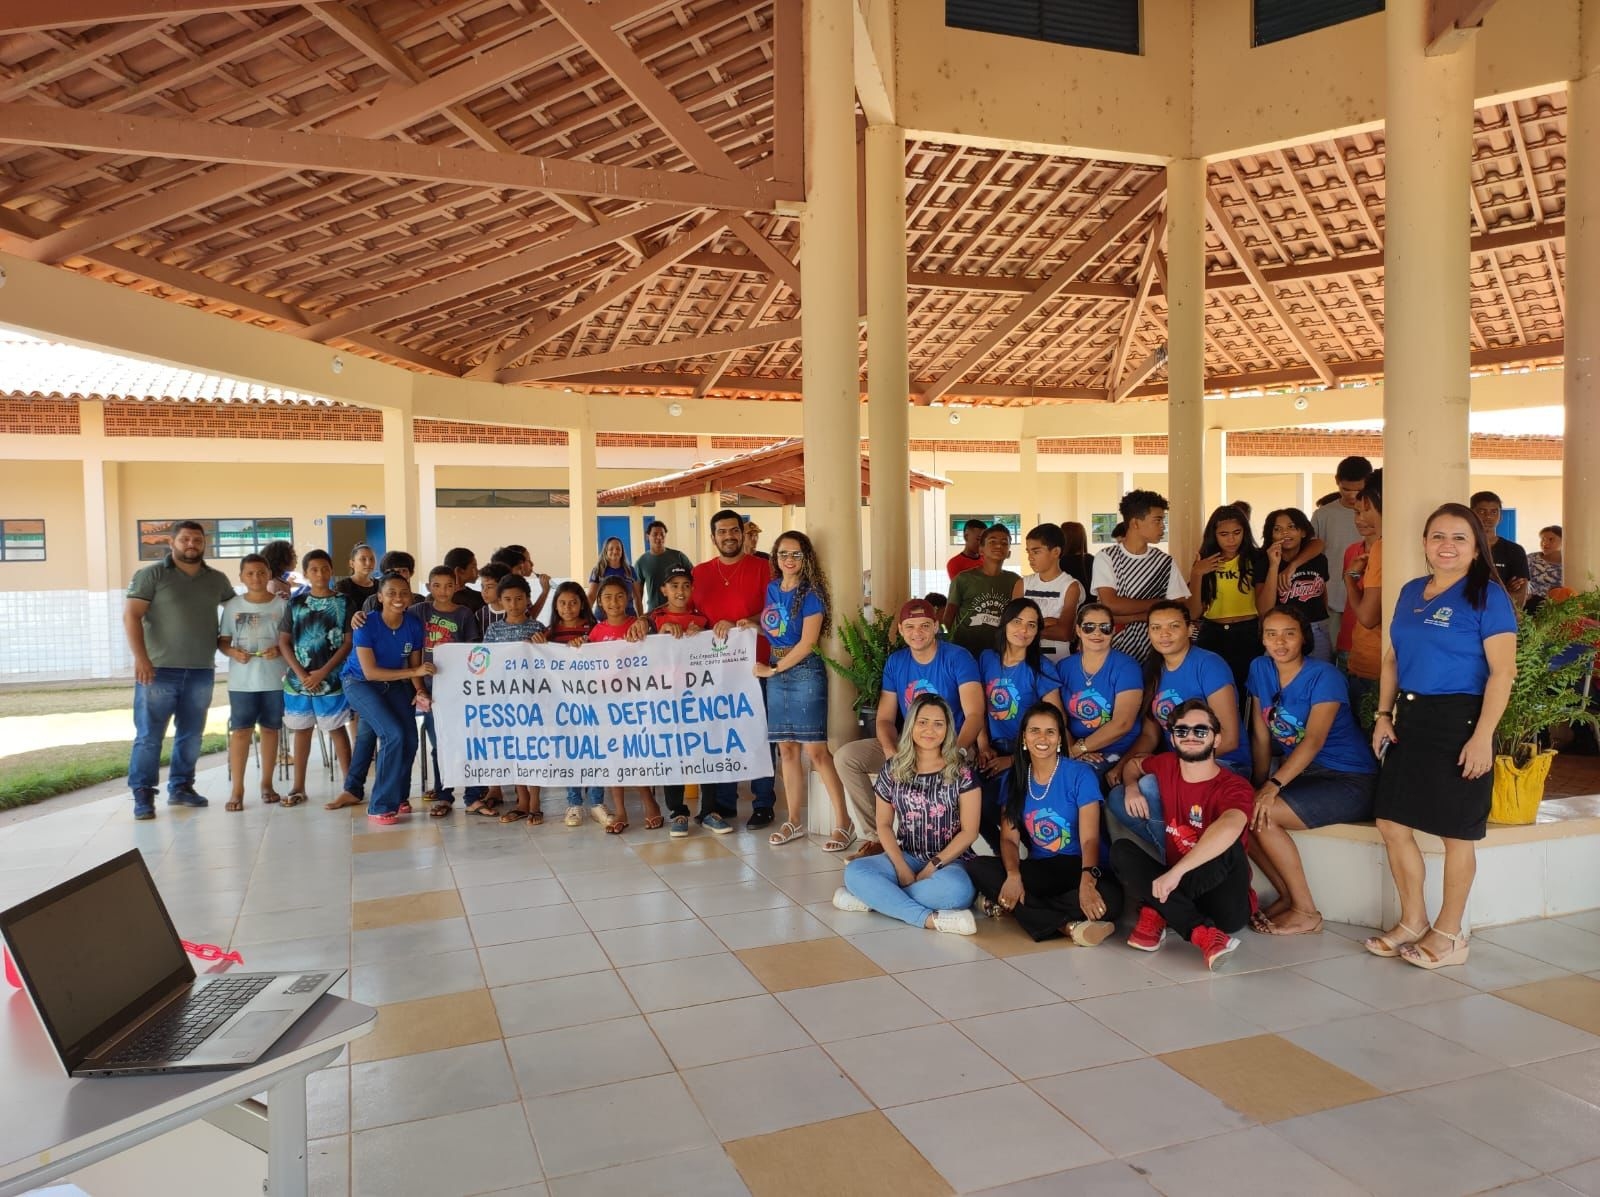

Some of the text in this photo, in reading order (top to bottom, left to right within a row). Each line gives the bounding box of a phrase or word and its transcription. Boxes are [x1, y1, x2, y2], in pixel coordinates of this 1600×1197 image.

[505, 655, 649, 671] 21 A 28 DE AGOSTO 2022
[462, 670, 715, 697] SEMANA NACIONAL DA
[464, 690, 755, 728] PESSOA COM DEFICIÊNCIA
[465, 727, 747, 761] INTELECTUAL e MÚLTIPLA
[464, 757, 748, 784] Superar barreiras para garantir inclusão.
